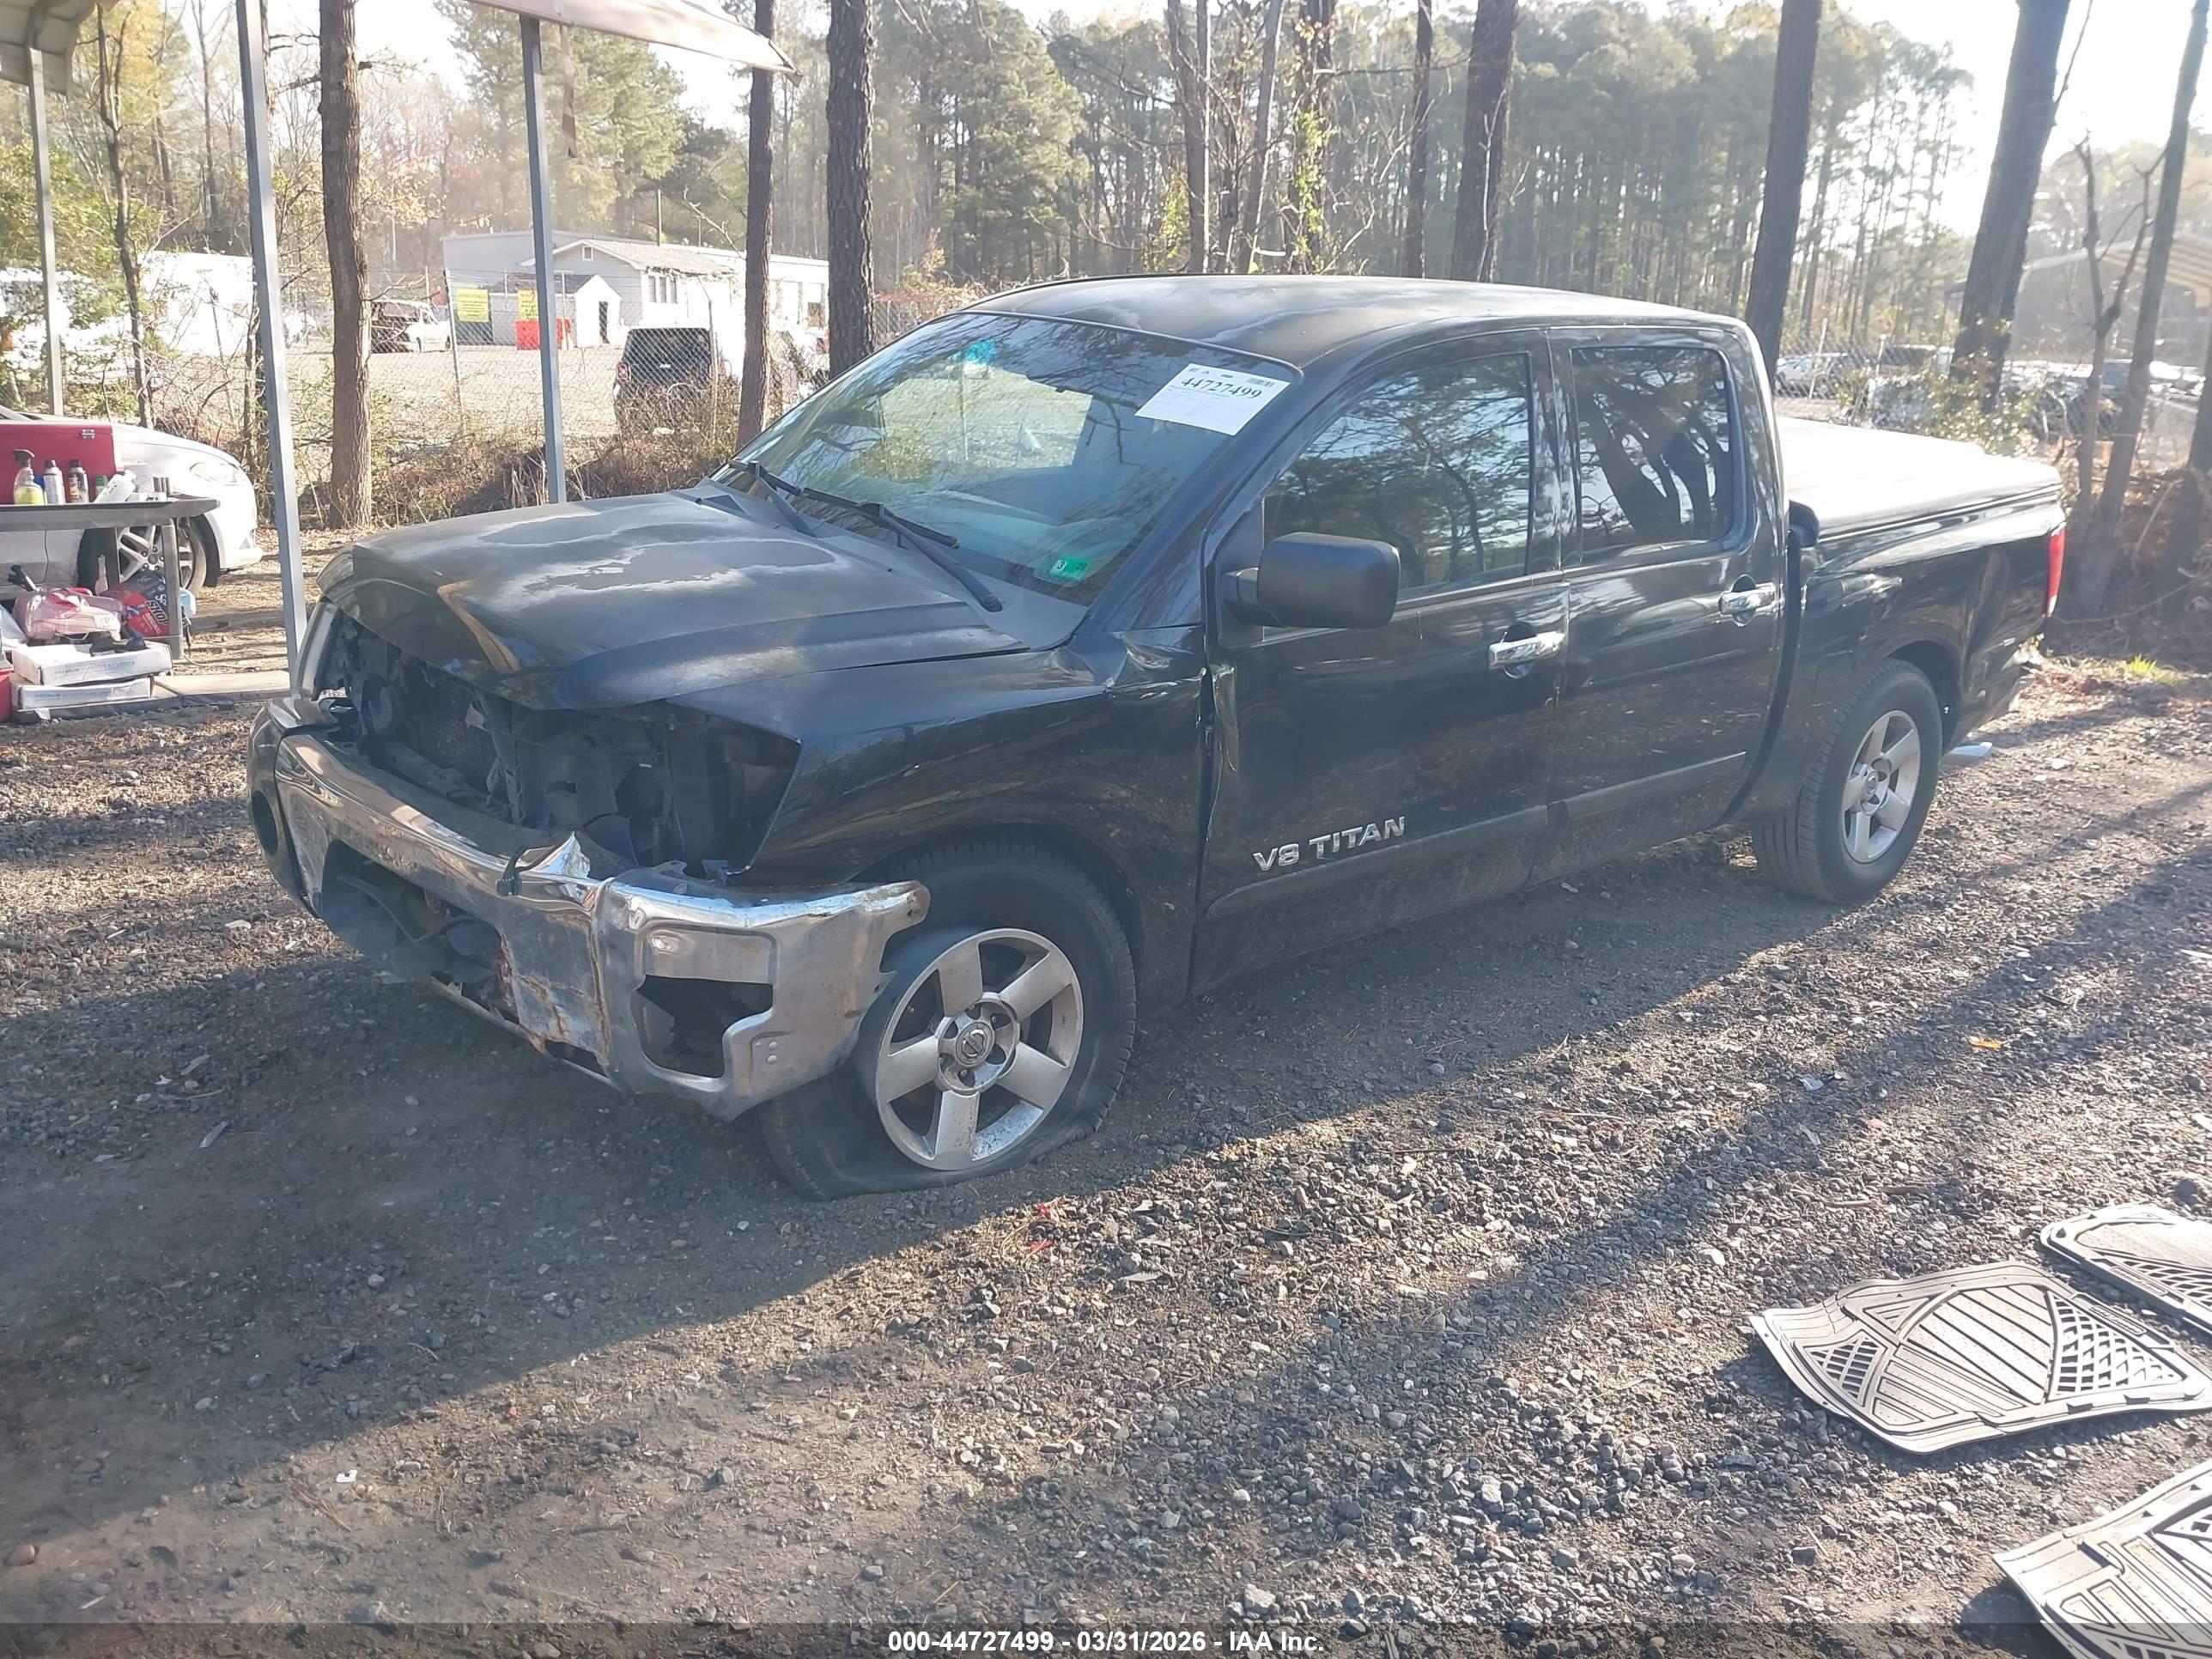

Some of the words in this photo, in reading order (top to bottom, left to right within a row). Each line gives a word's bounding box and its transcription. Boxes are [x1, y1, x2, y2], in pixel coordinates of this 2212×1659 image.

[1182, 377, 1263, 399] 44727499
[1056, 561, 1066, 570] 3
[1252, 842, 1300, 872] V8
[1309, 816, 1406, 860] TITAN
